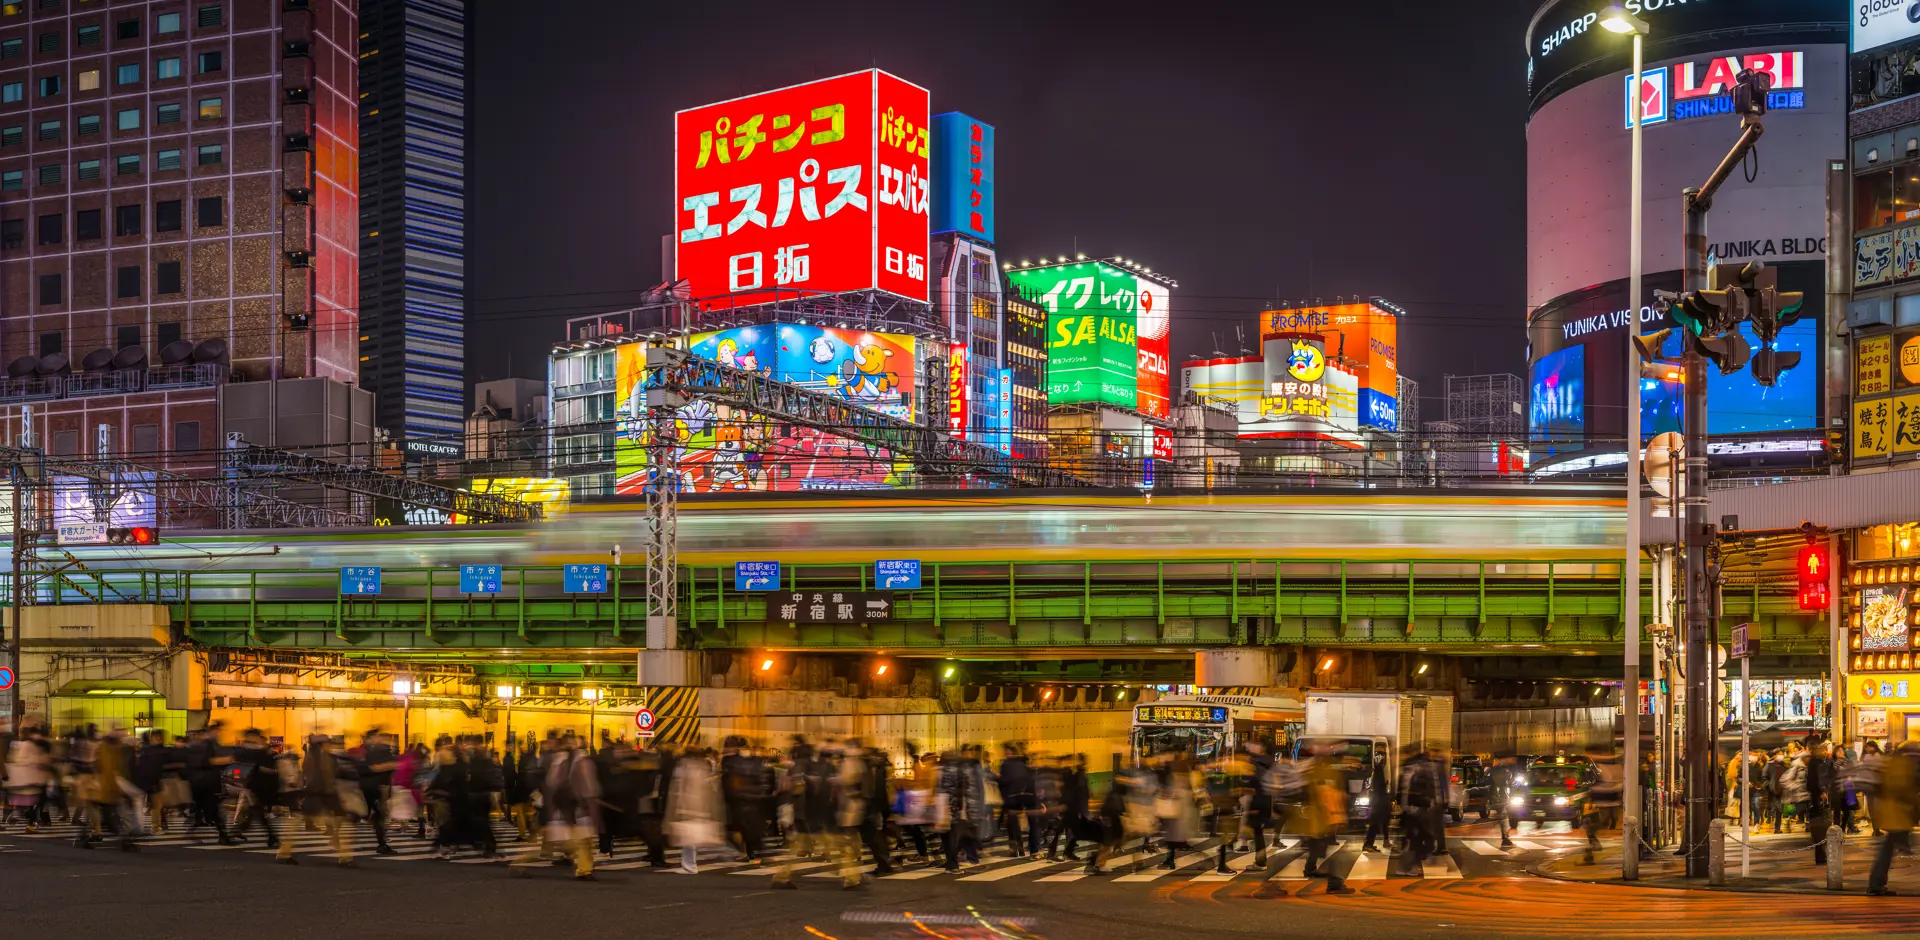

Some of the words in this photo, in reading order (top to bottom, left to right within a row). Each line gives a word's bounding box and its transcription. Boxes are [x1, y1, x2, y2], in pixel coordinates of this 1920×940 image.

[1624, 0, 1703, 15] SO
[1541, 12, 1597, 56] SHARP
[1674, 52, 1803, 99] LABI
[695, 103, 845, 169] パチンコ
[880, 105, 928, 159] パチンコ
[681, 158, 868, 244] エスパス
[880, 163, 928, 218] エスパス
[1707, 239, 1777, 259] YUNIKA
[729, 243, 810, 293] 日拓
[885, 246, 924, 281] 日拓
[1101, 281, 1135, 313] レイク
[1099, 316, 1135, 347] ALSA
[1271, 312, 1329, 328] PROMISE
[1335, 316, 1357, 324] プロミス
[1563, 314, 1608, 339] YUNIKA
[1610, 306, 1664, 327] VISON
[1139, 349, 1167, 375] アコム
[1370, 337, 1395, 361] PROMISE
[1860, 342, 1889, 354] 生ビール
[1379, 401, 1395, 423] 50m
[1860, 408, 1873, 449] 焼鳥
[1875, 401, 1888, 452] おでん
[408, 442, 428, 451] HOTEL
[60, 525, 105, 536] 新宿大ガード西
[739, 562, 777, 571] 新宿駅東口
[878, 561, 917, 569] 新宿駅東口
[781, 604, 853, 620] 新宿駅
[792, 593, 844, 603] 中央線
